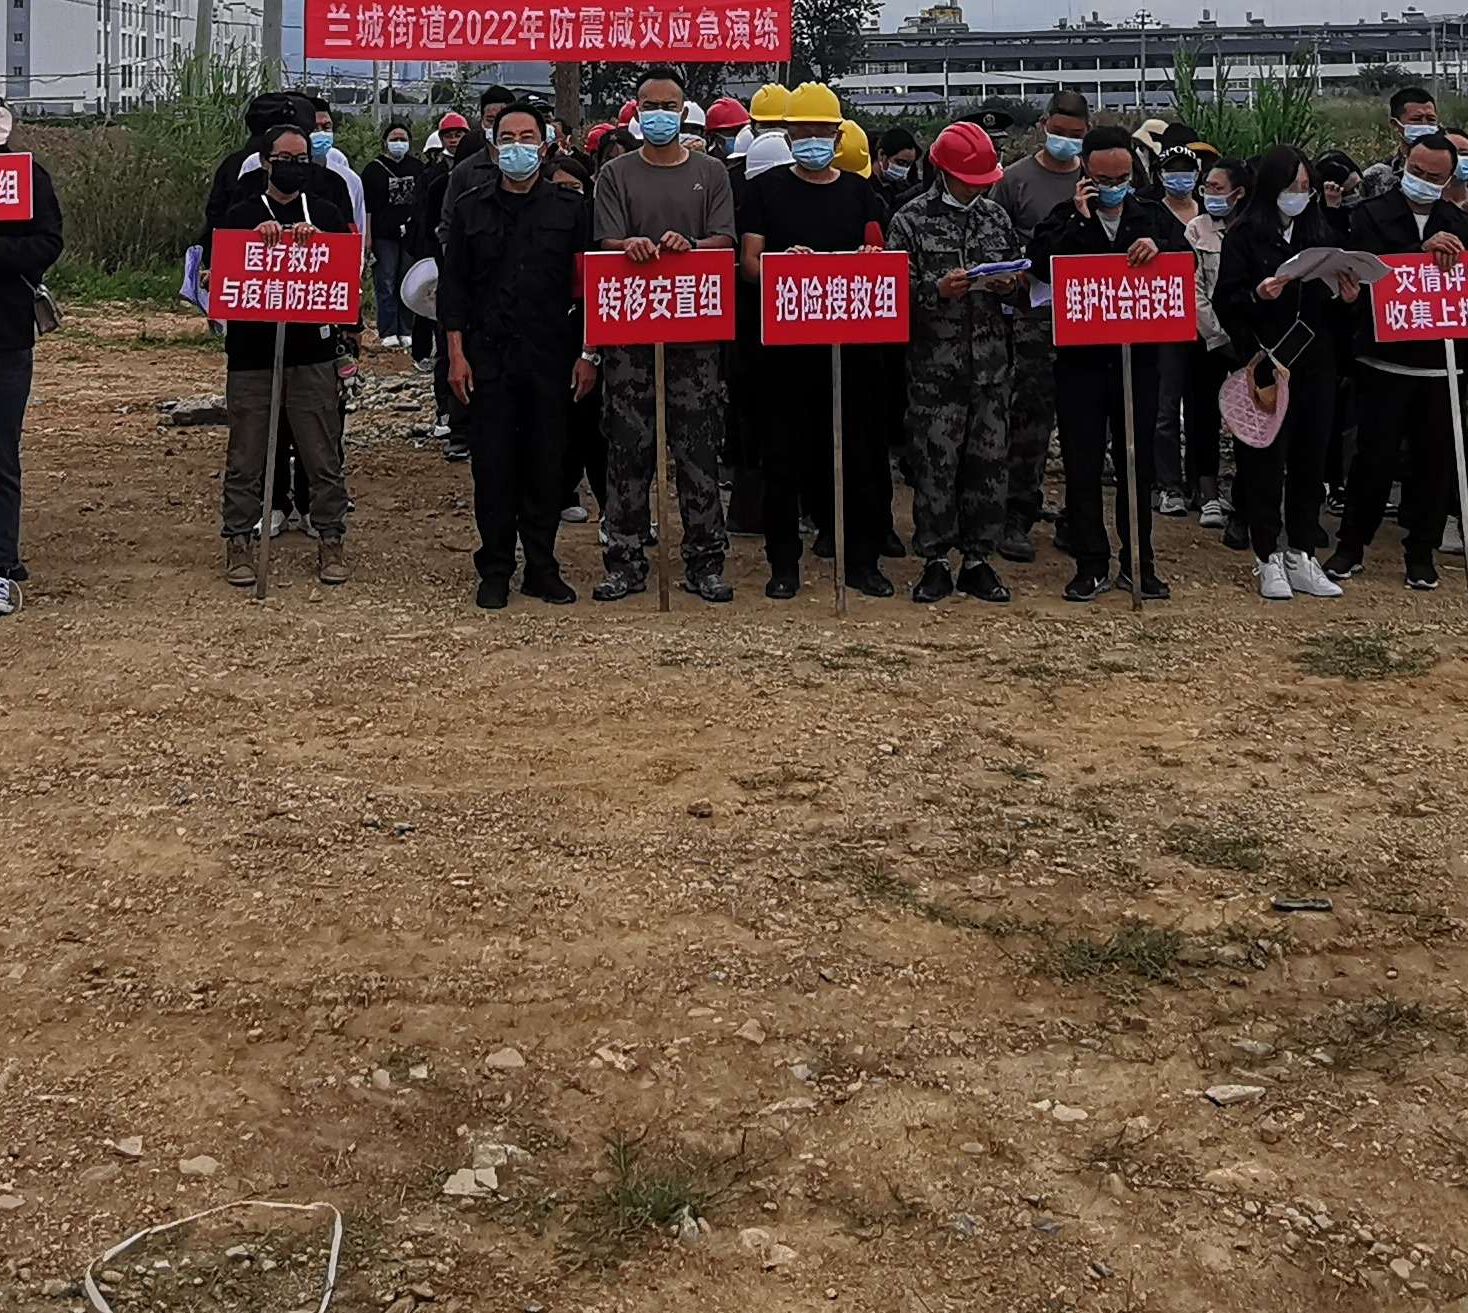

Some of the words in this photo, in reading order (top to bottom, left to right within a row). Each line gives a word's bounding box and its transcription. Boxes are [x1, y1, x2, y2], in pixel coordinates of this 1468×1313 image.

[324, 3, 780, 51] 兰城街道2022年防震减灾应急演练
[244, 241, 330, 273] 医疗救护
[220, 277, 349, 311] 与疫情防控组
[597, 273, 723, 322] 转移安置组
[776, 275, 898, 322] 抢险搜救组
[1065, 275, 1185, 323] 维护社会治安组
